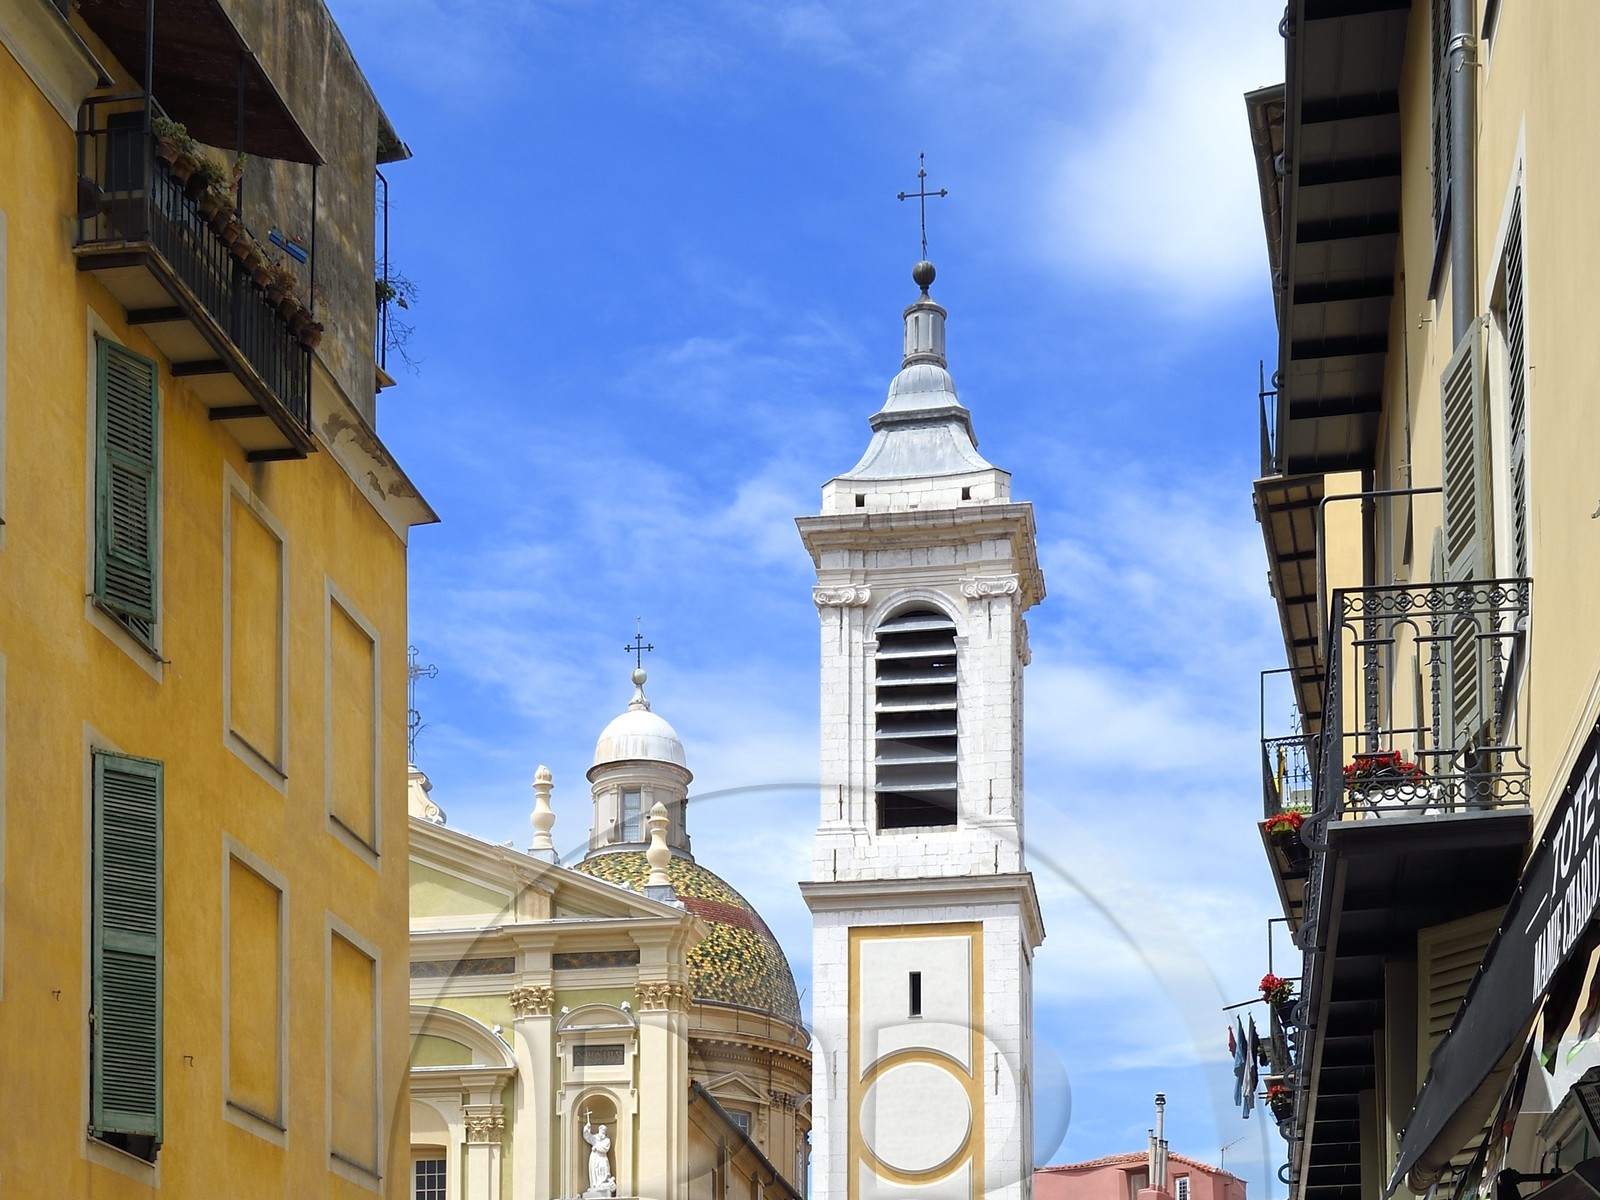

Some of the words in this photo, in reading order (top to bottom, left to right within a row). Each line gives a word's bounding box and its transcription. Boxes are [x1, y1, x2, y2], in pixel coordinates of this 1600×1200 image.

[1552, 750, 1600, 898] TOTE
[1532, 899, 1563, 1004] MAMIE
[1562, 828, 1600, 955] CHARLO
